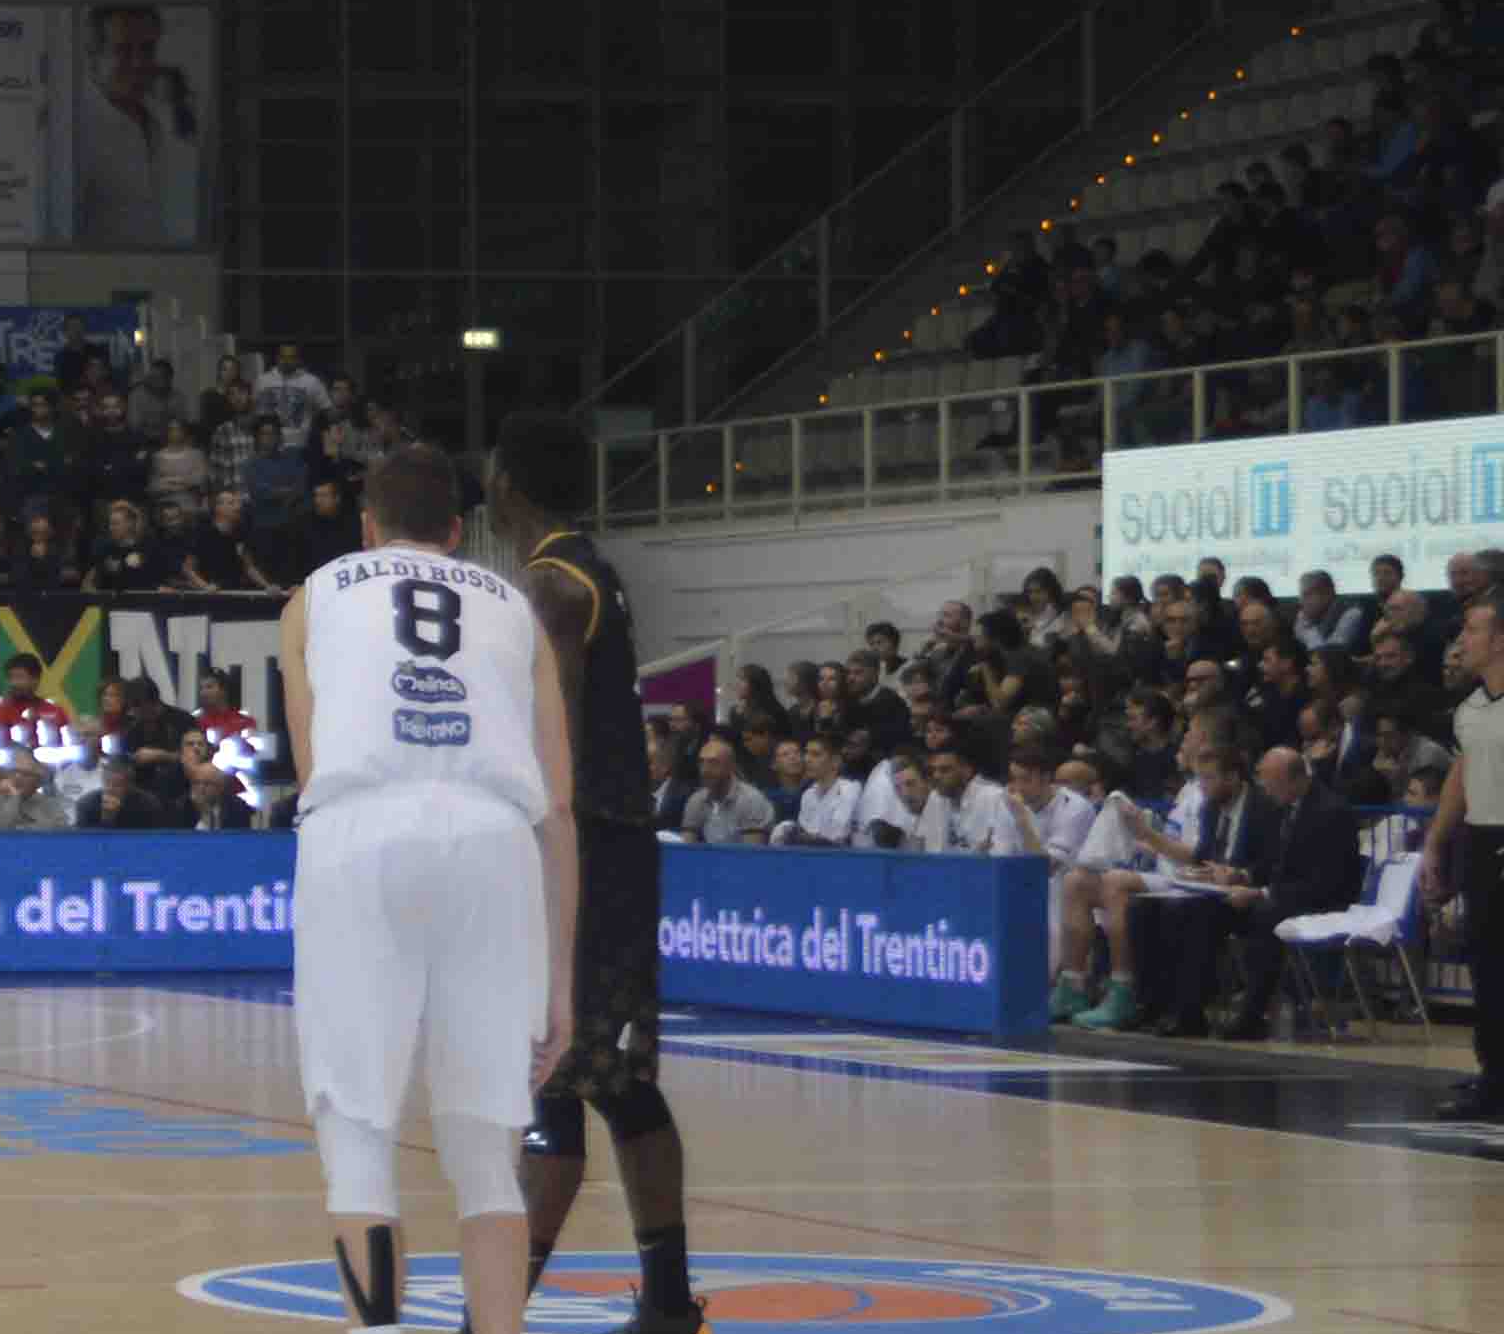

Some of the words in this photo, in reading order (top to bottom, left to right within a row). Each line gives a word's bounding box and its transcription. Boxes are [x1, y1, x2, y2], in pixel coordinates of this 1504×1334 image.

[1121, 469, 1241, 546] social
[1322, 443, 1464, 532] social
[334, 561, 422, 591] BALDI
[429, 564, 509, 602] ROSSI
[392, 578, 462, 662] 8
[15, 878, 107, 934] del
[123, 881, 296, 934] Trenti
[801, 905, 849, 972] del
[856, 910, 990, 985] Trentino
